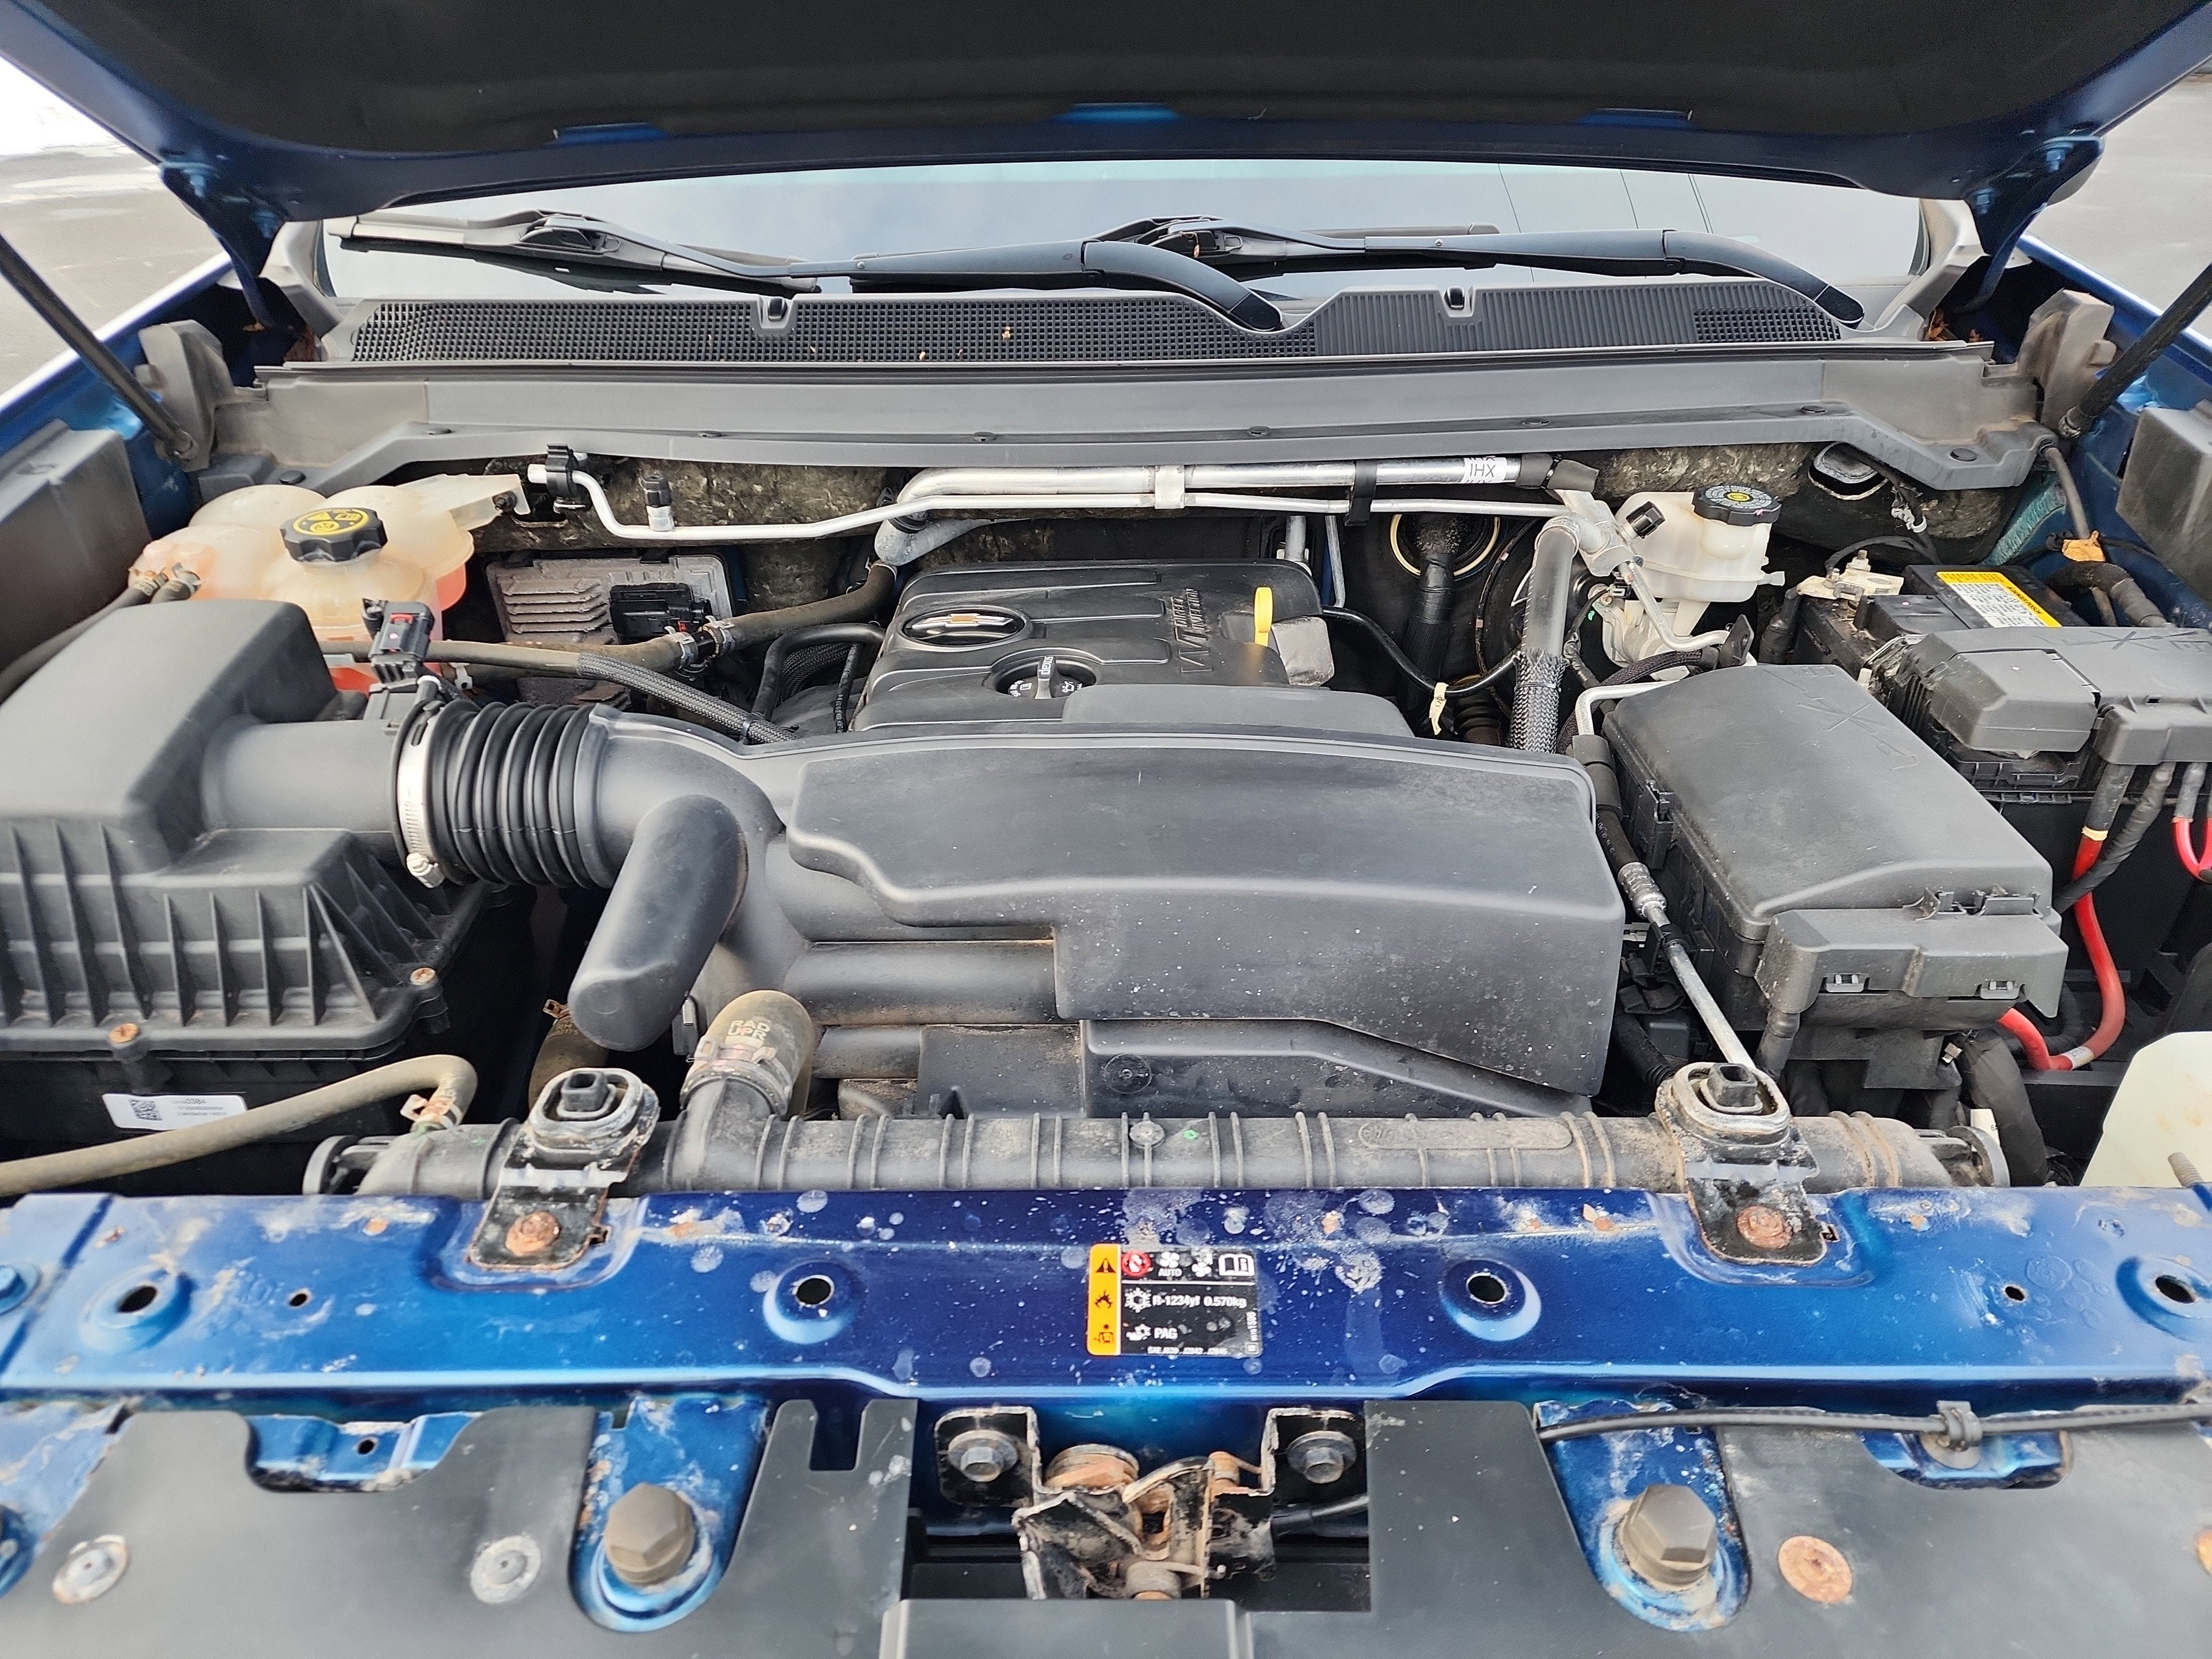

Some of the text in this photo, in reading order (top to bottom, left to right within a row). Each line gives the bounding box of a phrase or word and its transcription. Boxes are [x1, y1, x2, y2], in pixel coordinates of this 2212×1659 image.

[1470, 463, 1496, 477] IHX
[1185, 588, 1205, 630] INJECTION
[1039, 656, 1053, 675] dexos
[731, 1020, 770, 1032] RAD
[727, 1027, 767, 1041] UPR
[1158, 1268, 1182, 1277] AUTO
[1152, 1295, 1247, 1308] R-1234yf 0.570kg
[1154, 1327, 1178, 1339] PAG
